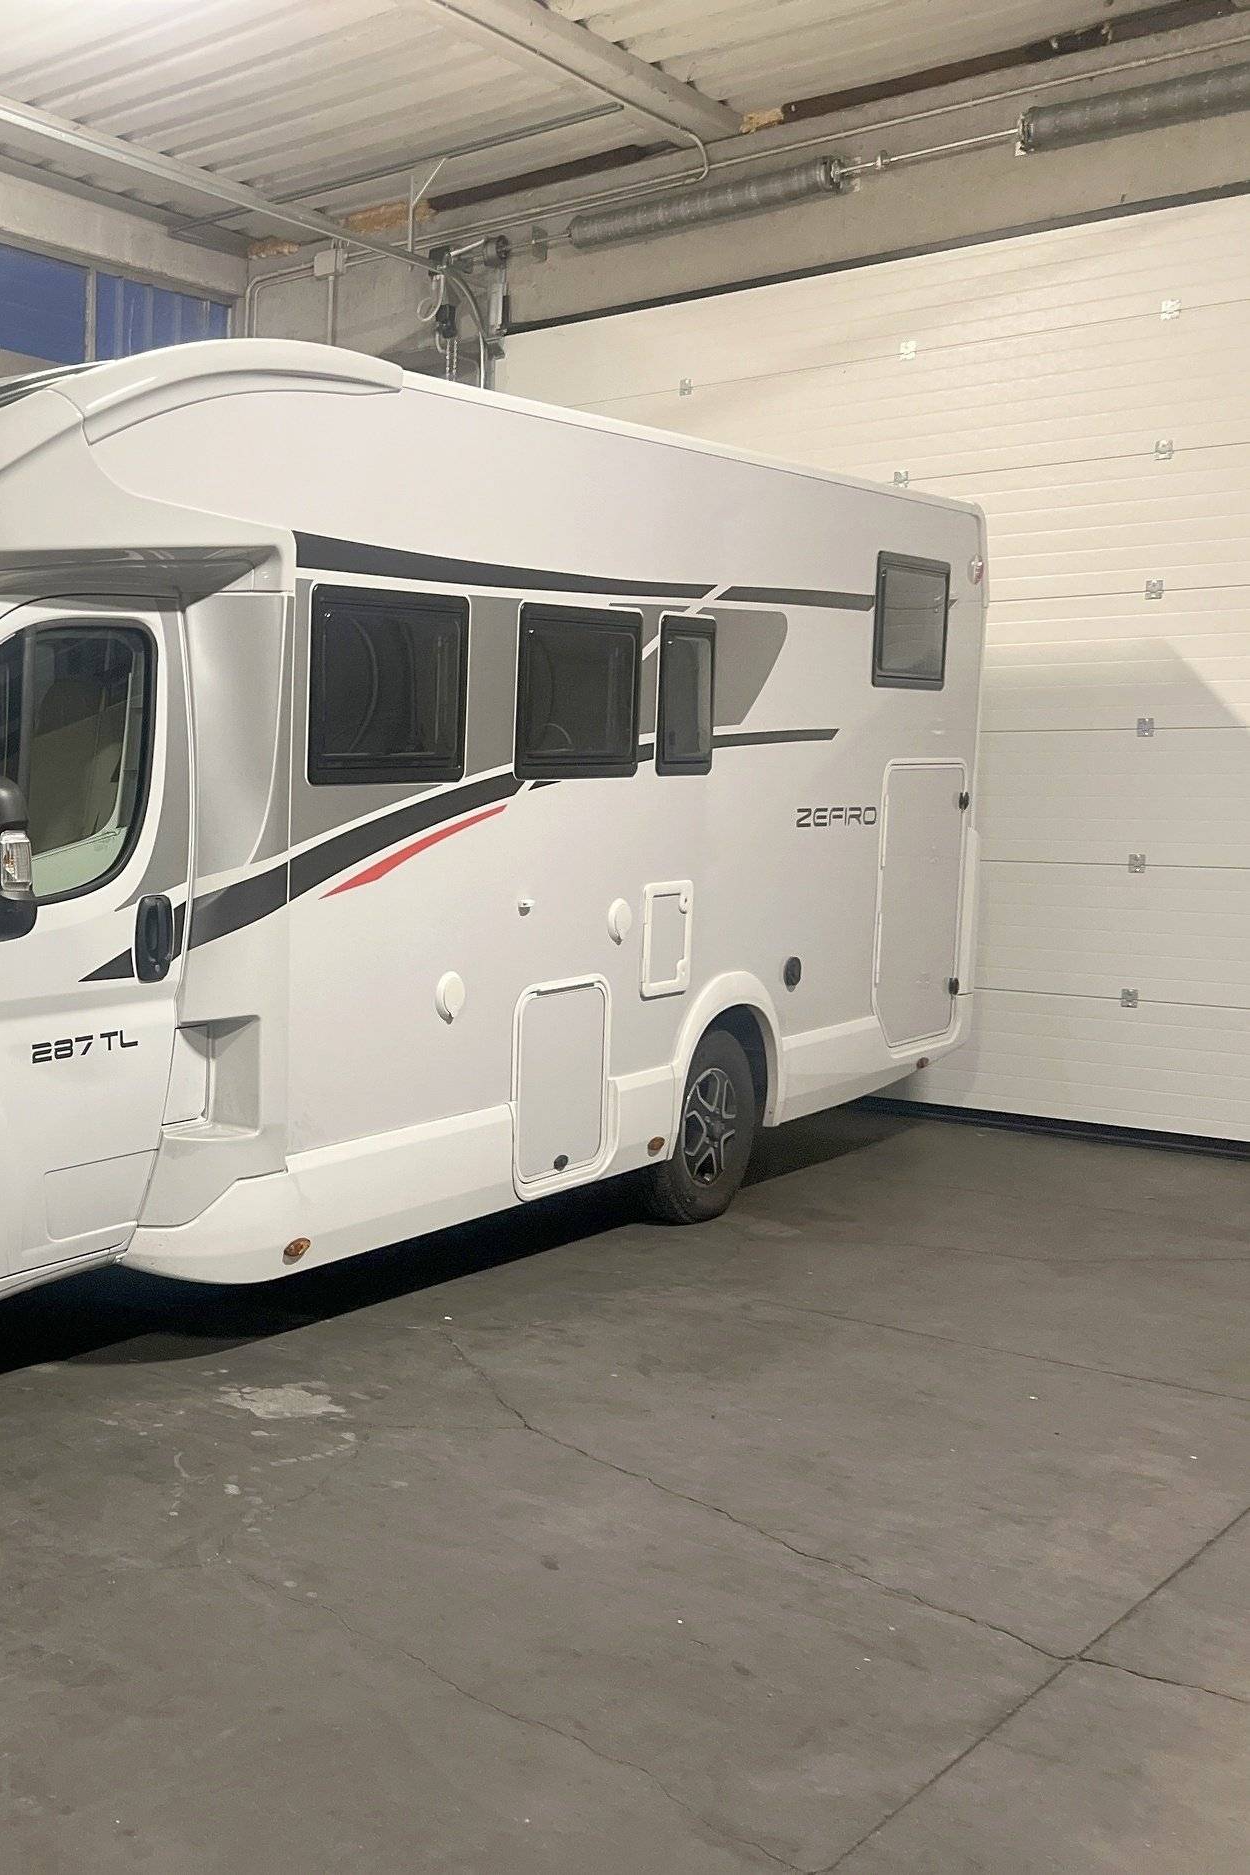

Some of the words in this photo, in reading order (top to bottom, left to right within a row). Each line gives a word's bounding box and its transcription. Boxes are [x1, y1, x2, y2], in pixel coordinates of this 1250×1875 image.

[796, 806, 877, 828] ZEFIRO
[31, 1034, 94, 1064] 287
[99, 1029, 139, 1052] TL
